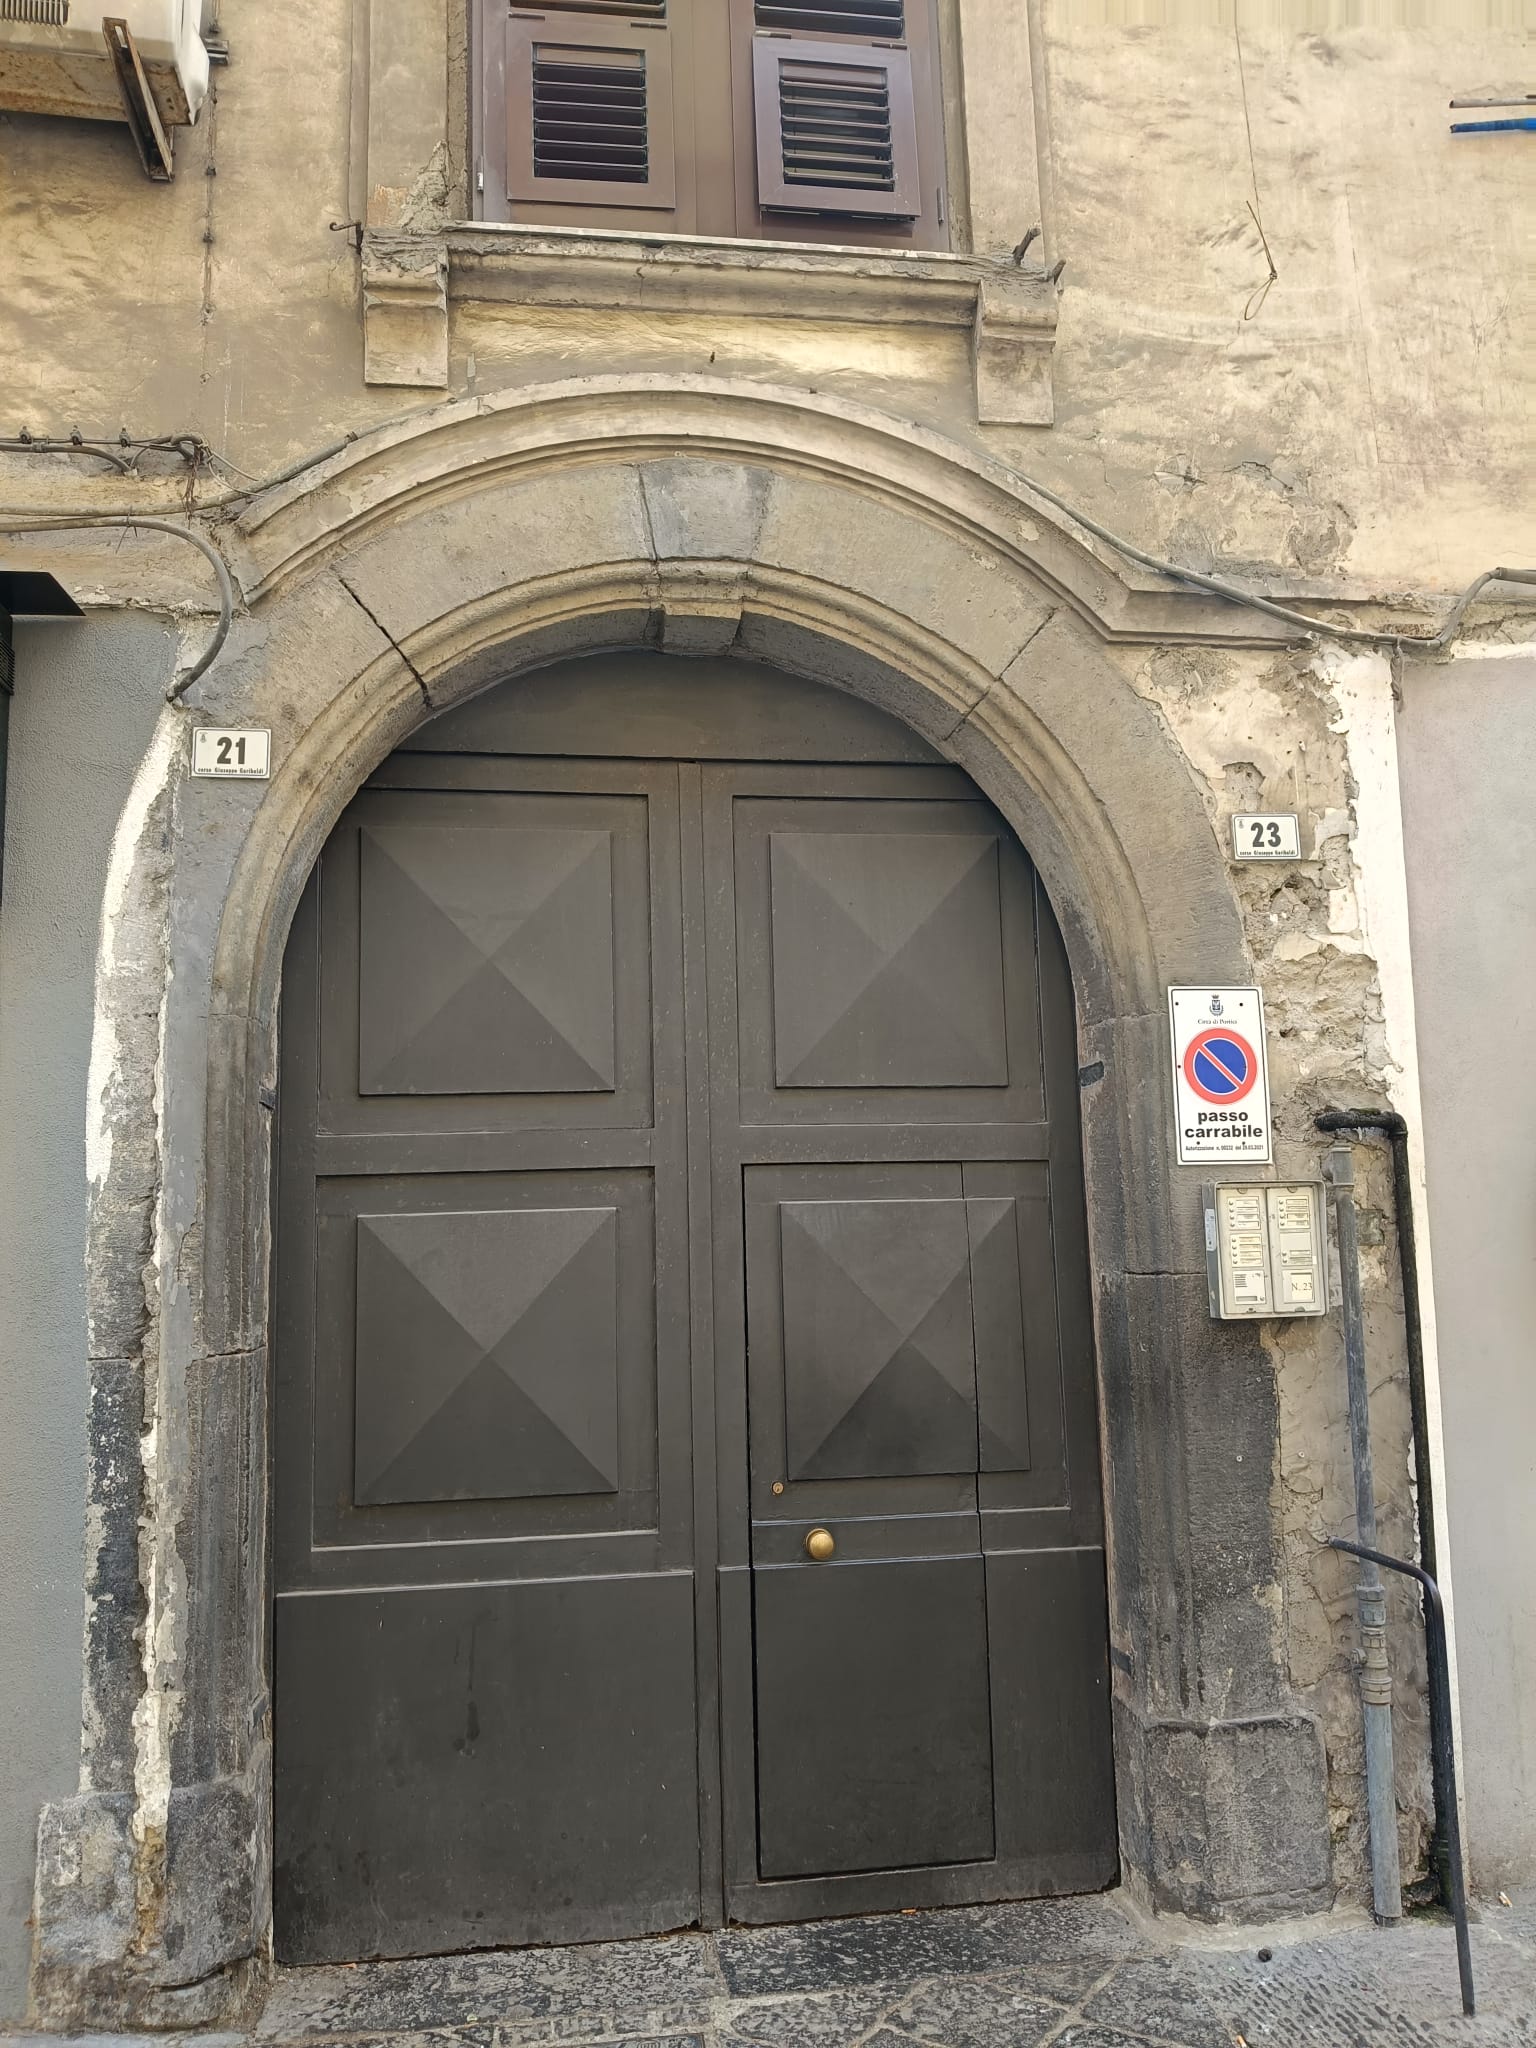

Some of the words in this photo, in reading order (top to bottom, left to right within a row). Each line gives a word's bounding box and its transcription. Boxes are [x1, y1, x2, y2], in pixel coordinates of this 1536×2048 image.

[217, 737, 245, 764] 21
[1251, 822, 1281, 847] 23
[1198, 1111, 1248, 1125] passo
[1185, 1125, 1263, 1138] carrabile
[1303, 1282, 1313, 1291] 23
